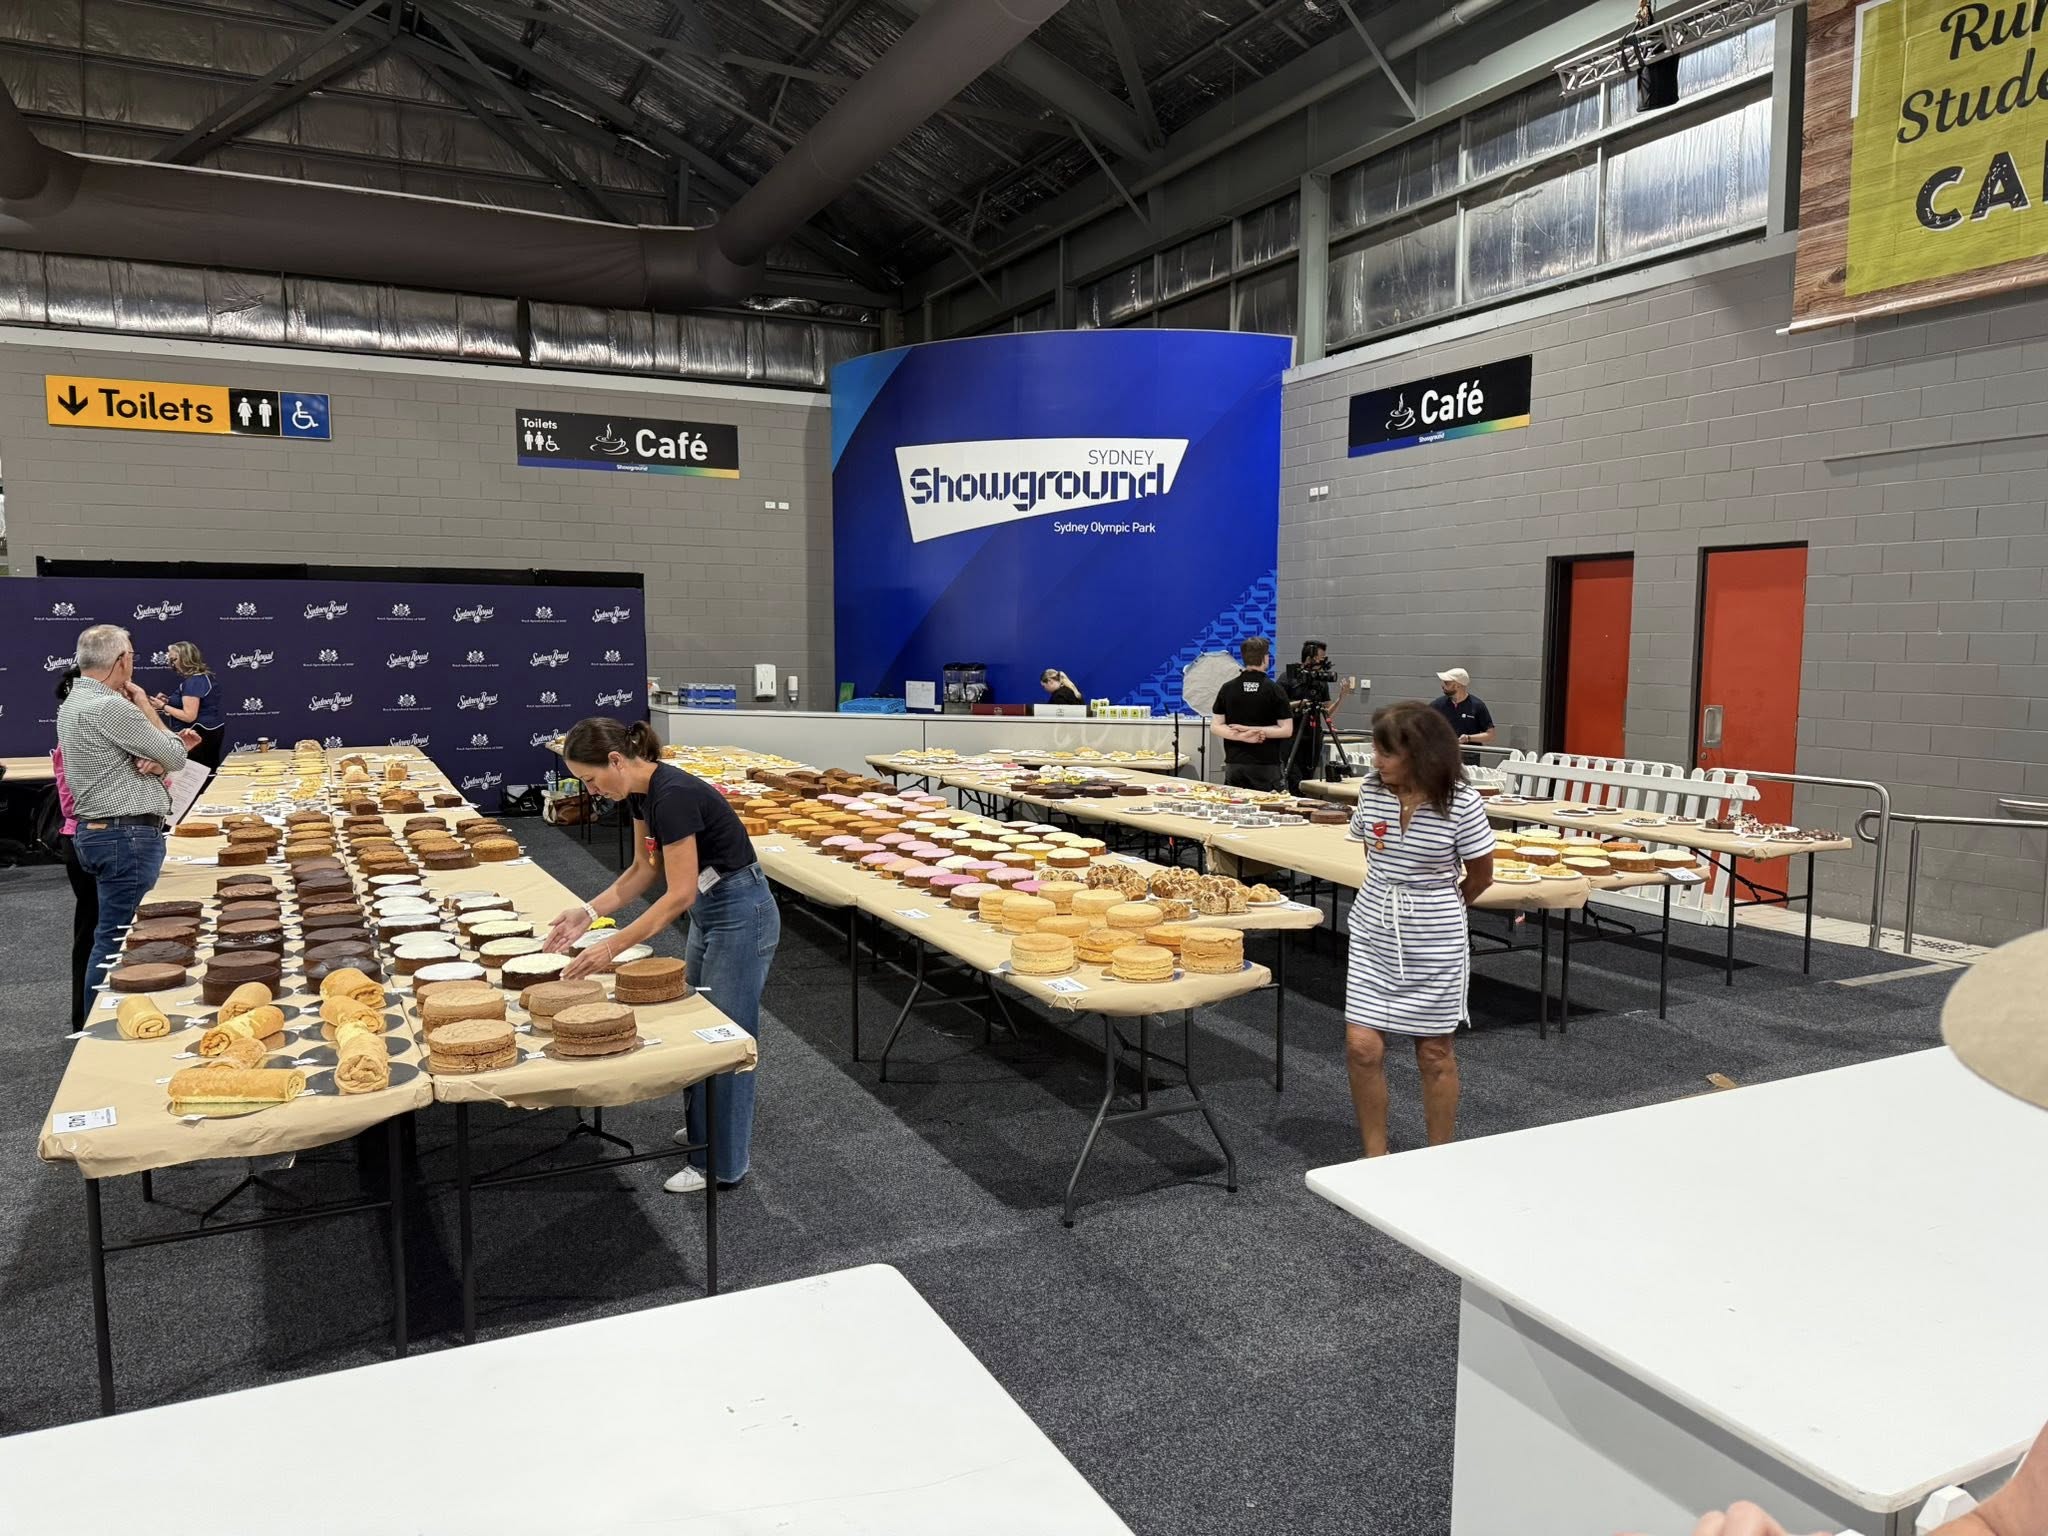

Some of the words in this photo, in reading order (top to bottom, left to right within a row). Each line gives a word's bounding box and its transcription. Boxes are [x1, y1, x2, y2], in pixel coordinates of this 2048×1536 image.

[1916, 139, 2048, 231] CA
[98, 388, 214, 424] Toilets
[1421, 380, 1485, 425] Café
[522, 417, 558, 430] Toilets
[635, 428, 708, 461] Café
[1088, 449, 1154, 465] SYDNEY
[909, 463, 1165, 511] Showground
[1053, 521, 1089, 534] Sydney
[1090, 521, 1130, 534] Olympic
[1132, 521, 1156, 534] Park
[133, 604, 161, 620] Sydney
[161, 600, 183, 616] Royal
[329, 600, 348, 615] Royal
[476, 604, 494, 619] Royal
[614, 606, 631, 620] Royal
[253, 649, 274, 664] Royal
[410, 649, 430, 665] Royal
[552, 648, 570, 663] Royal
[480, 691, 499, 705] Royal
[617, 688, 633, 703] Royal
[485, 771, 502, 785] Royal
